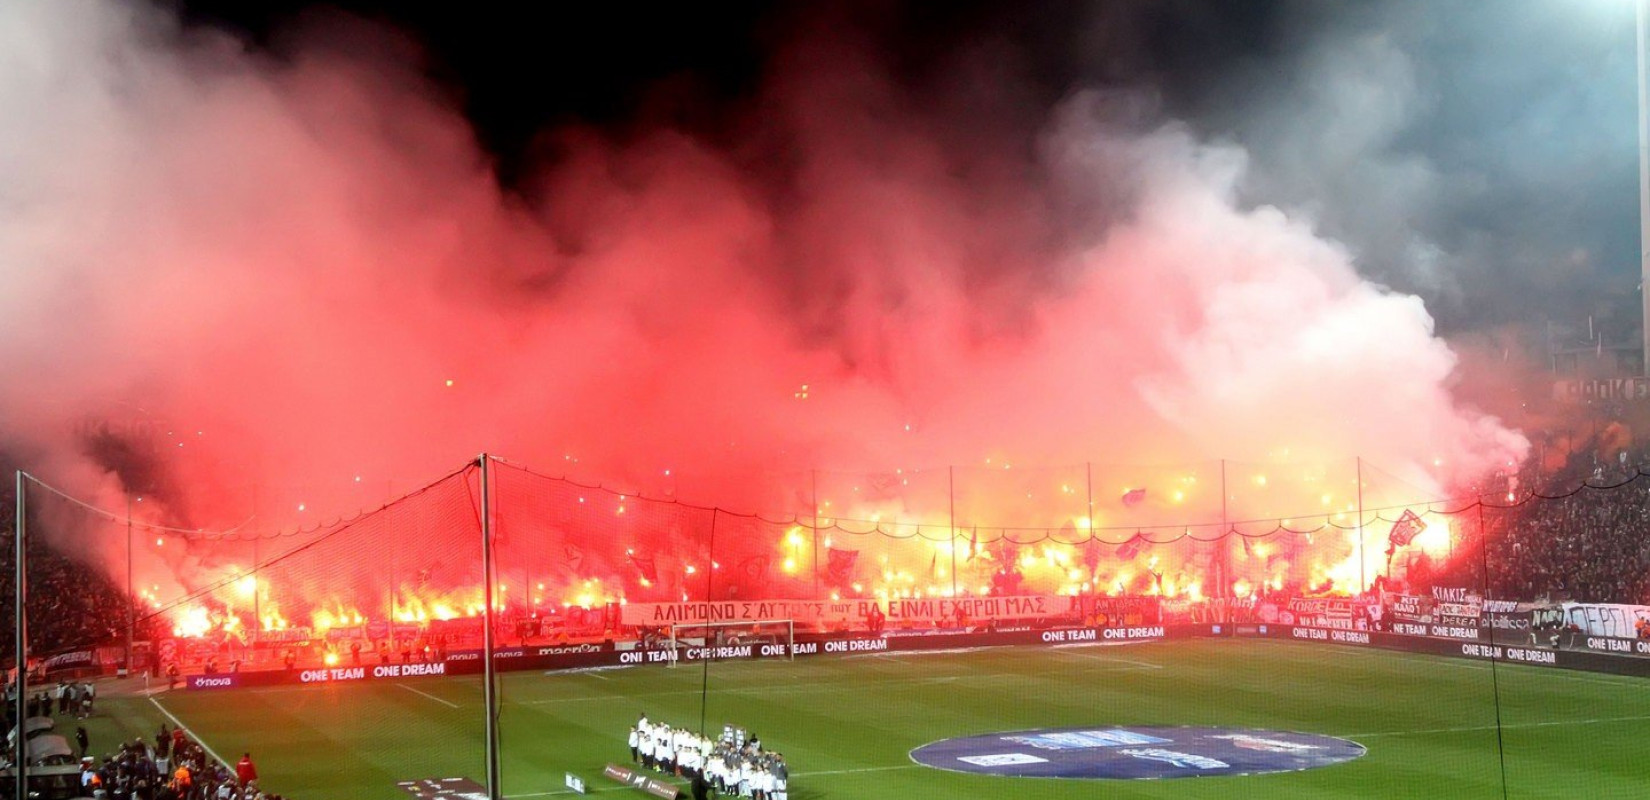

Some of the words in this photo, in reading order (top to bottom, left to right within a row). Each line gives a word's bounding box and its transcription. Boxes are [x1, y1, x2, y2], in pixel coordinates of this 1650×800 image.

[1432, 586, 1467, 602] ΚΙΛΚΙΣ
[654, 604, 735, 620] ΑΛΙΜΟΝΟ
[889, 600, 934, 617] ΕΙΝΑΙ
[1006, 597, 1047, 615] ΜΑΣ
[1042, 631, 1065, 641] ONE
[1067, 630, 1096, 640] TEAM
[1103, 628, 1126, 638] ONE
[1128, 627, 1164, 637] DREAM
[1292, 627, 1308, 638] ONE
[1309, 629, 1328, 640] TEAM
[1331, 630, 1346, 641] ONE
[1346, 631, 1370, 643] DREAM
[1405, 624, 1427, 635] TEAM
[1432, 626, 1449, 636] ONE
[1450, 627, 1478, 638] DREAM
[761, 644, 785, 656] ONE
[825, 641, 848, 652] ONE
[849, 639, 887, 650] DREAM
[1587, 637, 1607, 650] ONE
[1607, 638, 1631, 652] TEAM
[1462, 644, 1479, 656] ONE
[1480, 645, 1501, 658] TEAM
[1507, 648, 1525, 660] ONE
[1526, 650, 1556, 663] DREAM
[301, 670, 328, 682] ONE
[331, 668, 364, 680] TEAM
[374, 665, 400, 677] ONE
[402, 663, 445, 676] DREAM
[205, 678, 232, 686] nova
